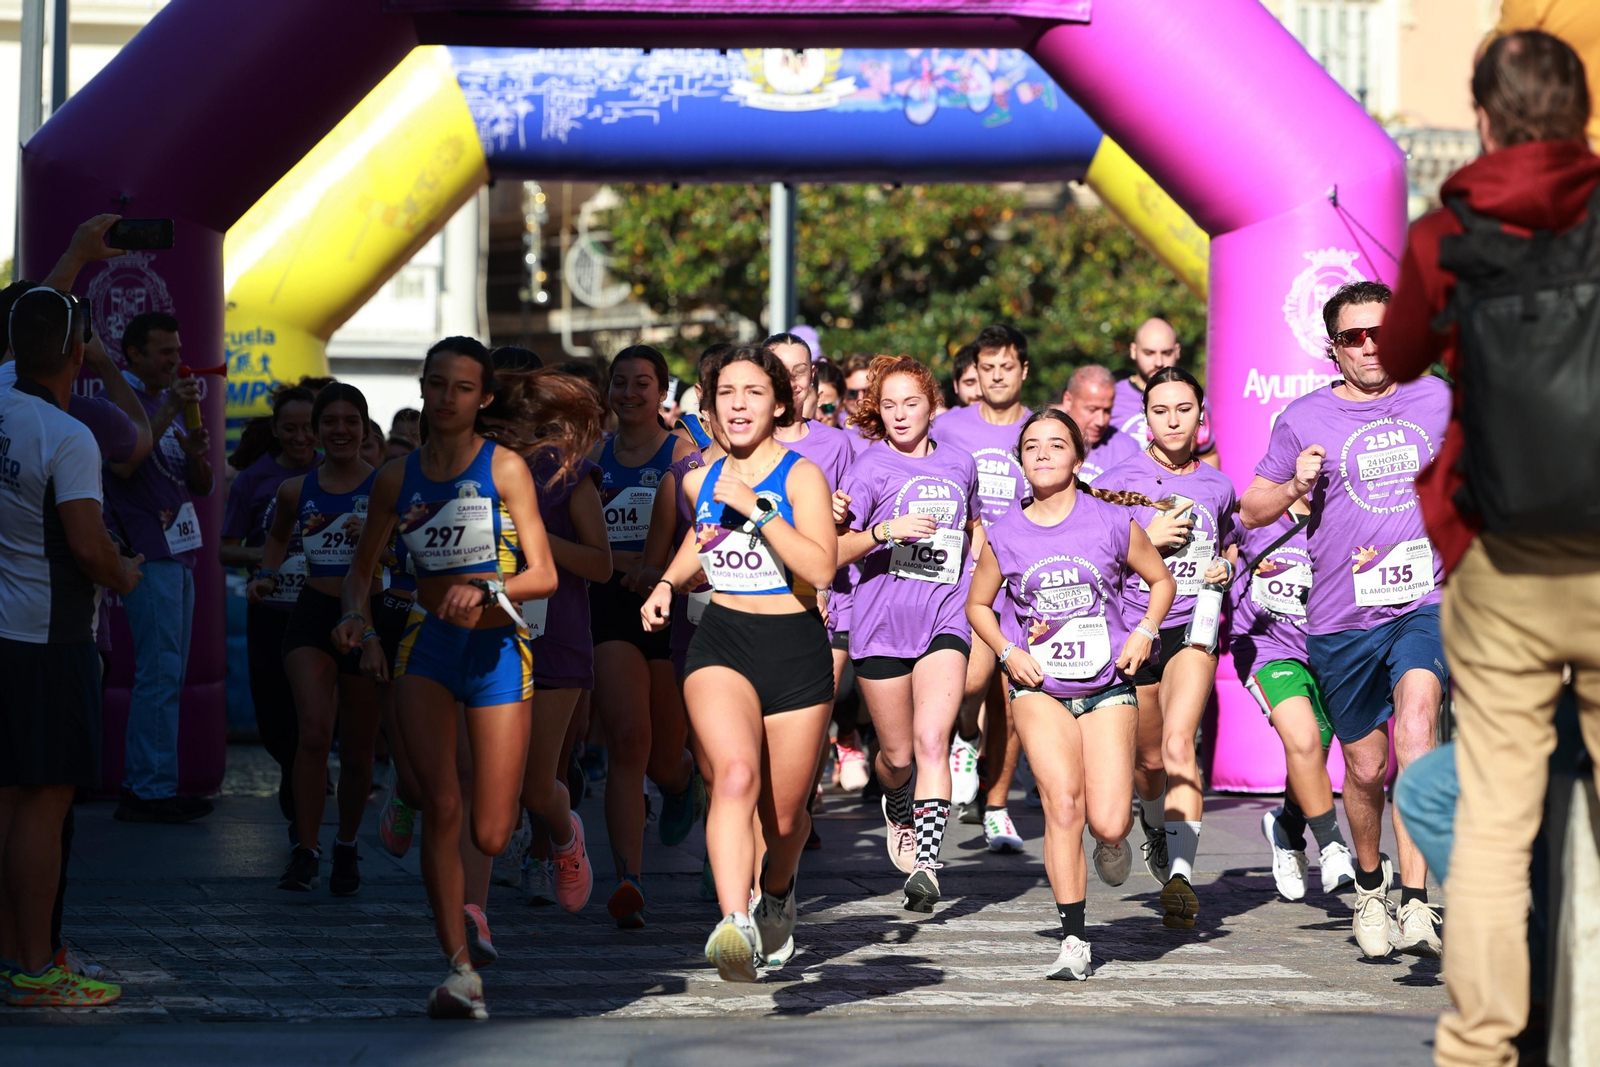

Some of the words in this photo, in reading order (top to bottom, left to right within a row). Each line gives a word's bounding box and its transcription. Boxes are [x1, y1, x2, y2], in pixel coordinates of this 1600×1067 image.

[1242, 368, 1345, 404] Ayunta
[1341, 417, 1394, 460] INTERNACIONAL
[1396, 419, 1430, 443] CONTRA
[1427, 442, 1435, 455] LA
[1363, 429, 1406, 451] 25N
[977, 458, 1010, 476] 25N
[1367, 459, 1378, 467] 24
[1378, 452, 1409, 465] HORAS
[1362, 467, 1382, 478] 900
[1382, 464, 1392, 473] 21
[1393, 462, 1402, 471] 21
[1403, 461, 1416, 470] 30
[895, 475, 942, 506] INTERNACIONAL
[942, 478, 966, 501] CONTRA
[917, 484, 951, 499] 25N
[1343, 480, 1371, 511] MUJERES
[1371, 506, 1389, 515] LAS
[1390, 499, 1416, 513] HACIA
[605, 508, 638, 525] 014
[176, 520, 195, 537] 182
[424, 526, 466, 548] 297
[442, 549, 451, 557] ES
[464, 545, 491, 554] LUCHA
[911, 545, 948, 565] 100
[1406, 544, 1428, 552] CARRERA
[712, 550, 763, 570] 300
[903, 561, 922, 569] AMOR
[733, 571, 744, 579] NO
[745, 570, 778, 579] LASTIMA
[1020, 555, 1071, 593] INTERNACIONAL
[1073, 556, 1102, 581] CONTRA
[1038, 567, 1080, 588] 25N
[1167, 561, 1197, 577] 425
[1378, 564, 1413, 585] 135
[1052, 589, 1082, 601] HORAS
[1369, 586, 1391, 595] AMOR
[1405, 580, 1429, 591] LASTIMA
[1066, 599, 1075, 607] 21
[1076, 595, 1090, 605] 30
[1051, 641, 1086, 660] 231
